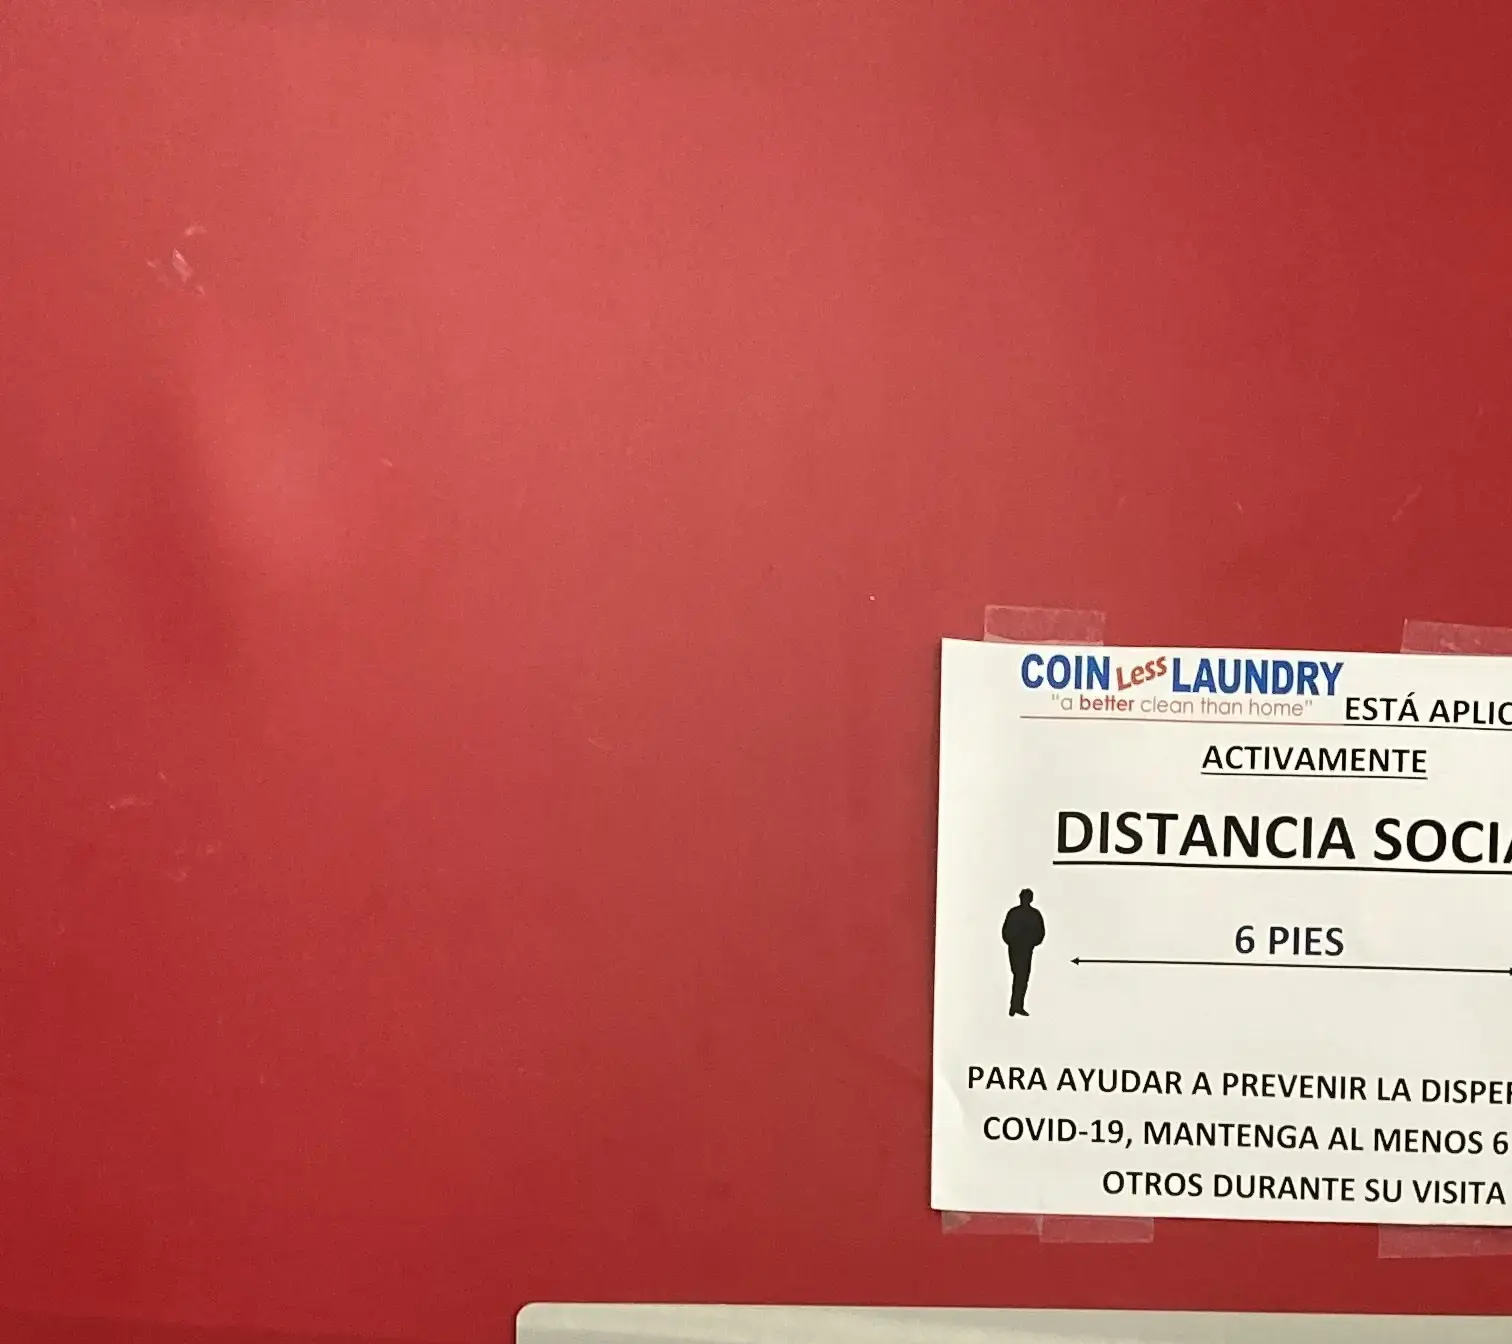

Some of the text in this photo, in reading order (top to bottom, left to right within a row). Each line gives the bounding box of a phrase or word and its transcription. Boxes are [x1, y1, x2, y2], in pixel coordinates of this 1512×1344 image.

[1021, 654, 1344, 696] COIN Less LAUNDRY
[1344, 688, 1419, 723] ESTÁ
[1202, 746, 1427, 774] ACTIVAMENTE
[1056, 811, 1355, 860] DISTANCIA
[1236, 925, 1343, 956] 6 PIES
[969, 1066, 1047, 1090] PARA
[1057, 1068, 1182, 1094] AYUDAR
[1192, 1072, 1212, 1095] A
[1223, 1073, 1366, 1100] PREVENIR
[1378, 1077, 1411, 1102] LA
[984, 1117, 1132, 1149] COVID-19,
[1144, 1121, 1319, 1149] MANTENGA
[1328, 1127, 1364, 1150] AL
[1374, 1128, 1482, 1154] MENOS
[1493, 1132, 1508, 1155] 6
[1103, 1171, 1506, 1205] OTROS DURANTE SU VISITA
